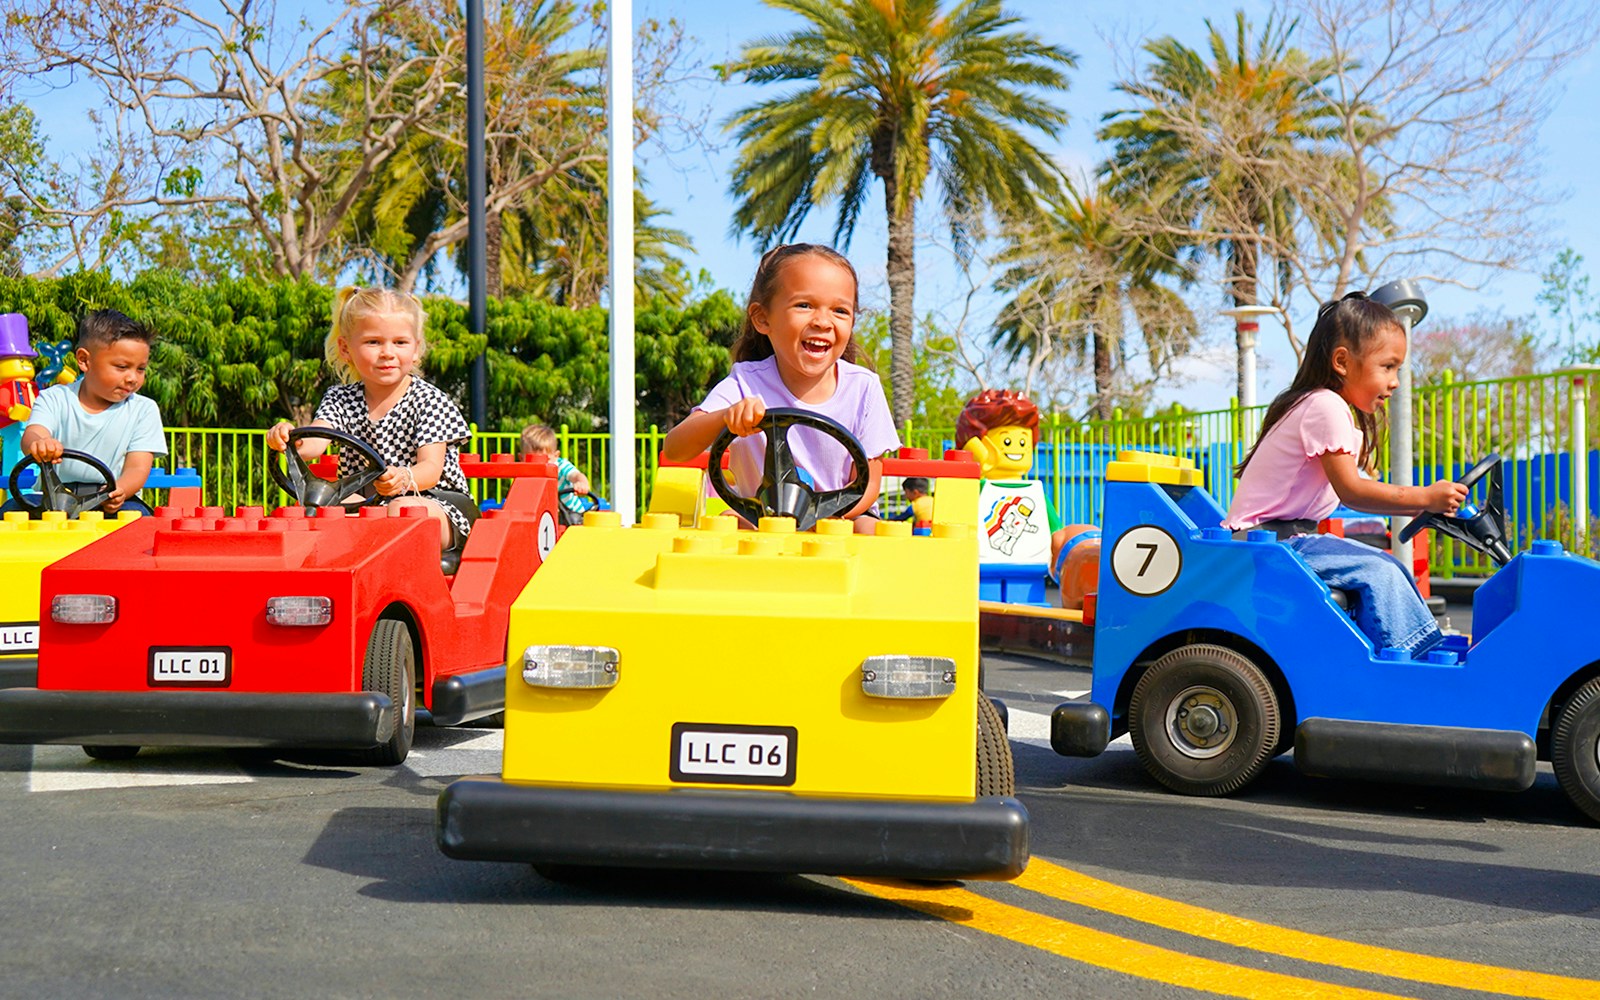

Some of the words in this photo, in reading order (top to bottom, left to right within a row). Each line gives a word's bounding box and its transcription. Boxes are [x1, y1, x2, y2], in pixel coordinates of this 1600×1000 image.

[543, 525, 550, 551] 1
[1136, 543, 1158, 577] 7
[3, 631, 33, 644] LLC
[159, 658, 191, 674] LLC
[199, 658, 220, 674] 01
[688, 742, 736, 764] LLC
[748, 744, 781, 766] 06
